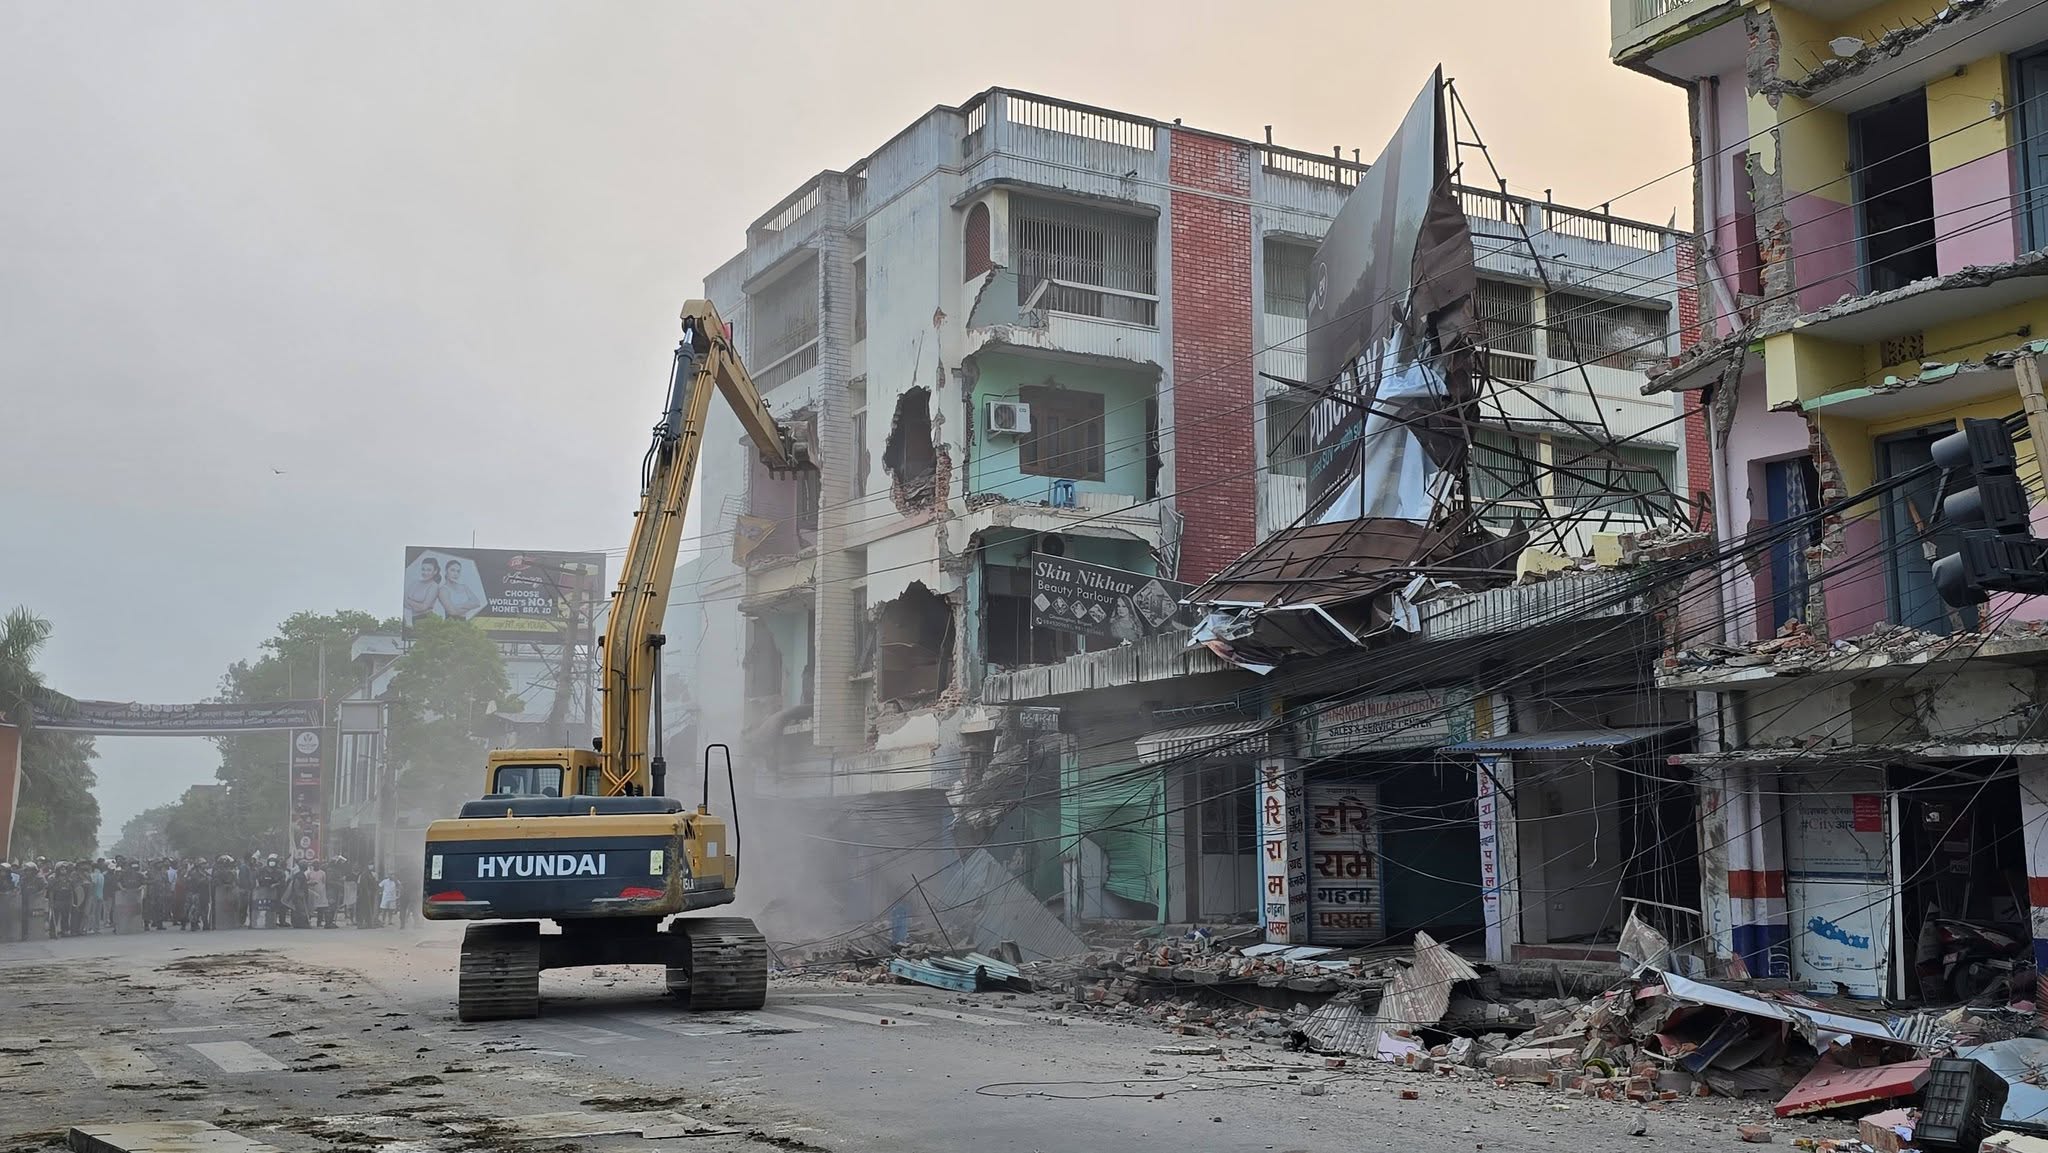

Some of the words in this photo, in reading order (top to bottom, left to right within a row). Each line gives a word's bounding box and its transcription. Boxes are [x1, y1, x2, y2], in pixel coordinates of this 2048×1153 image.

[676, 445, 695, 519] HYUNDAI
[1035, 561, 1071, 582] Skin
[1075, 569, 1134, 594] Nikhar
[505, 590, 540, 598] CHOOSE
[1037, 579, 1073, 598] Beauty
[1077, 587, 1114, 604] Parlour
[489, 598, 527, 606] WORLD'S
[528, 598, 553, 607] NO.1
[1314, 796, 1371, 835] हरि
[478, 854, 606, 878] HYUNDAI
[1314, 850, 1373, 879] राम
[1317, 887, 1372, 905] गहना
[1267, 903, 1286, 918] गहना
[1319, 911, 1373, 928] पसल
[1268, 921, 1288, 937] पसल
